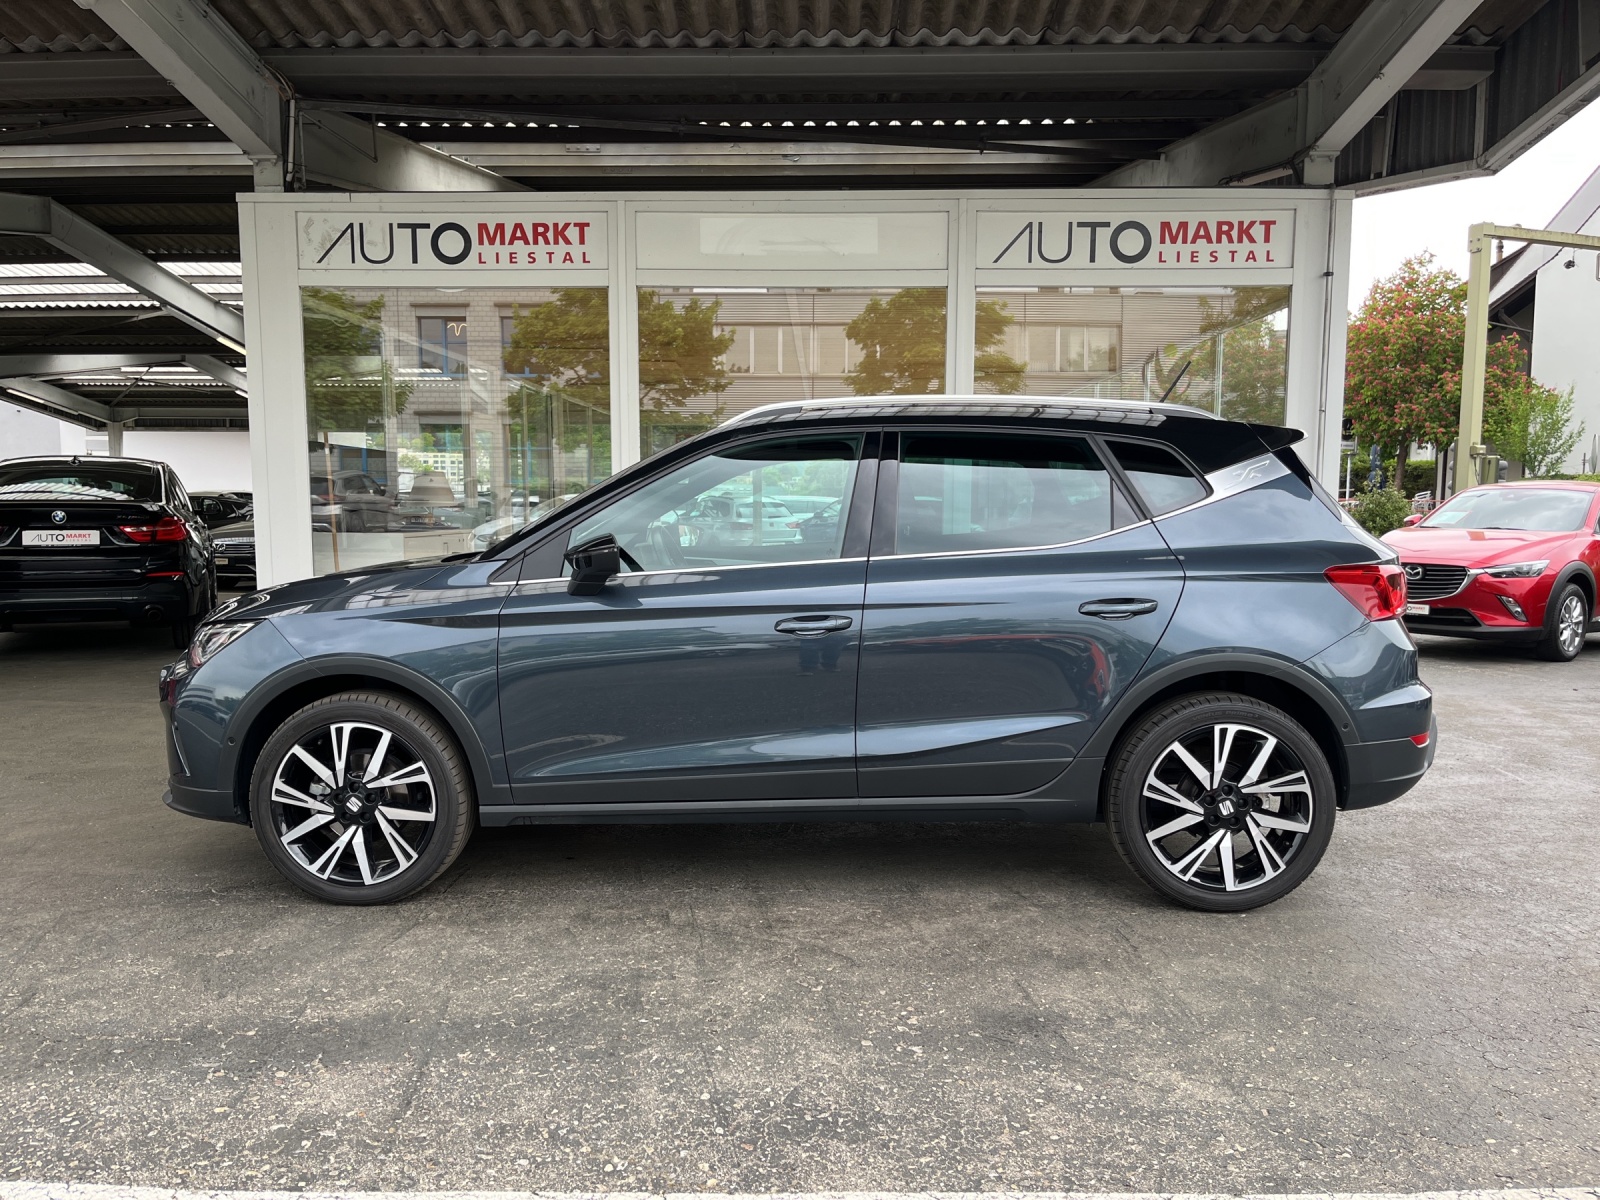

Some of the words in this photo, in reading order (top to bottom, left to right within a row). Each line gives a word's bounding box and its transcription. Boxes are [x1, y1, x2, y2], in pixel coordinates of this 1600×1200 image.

[317, 222, 472, 265] AUTO
[478, 222, 590, 246] MARKT
[992, 220, 1152, 264] AUTO
[1159, 220, 1277, 245] MARKT
[478, 252, 590, 264] LIESTAL
[1158, 250, 1275, 263] LIESTAL
[31, 534, 65, 543] AUTO
